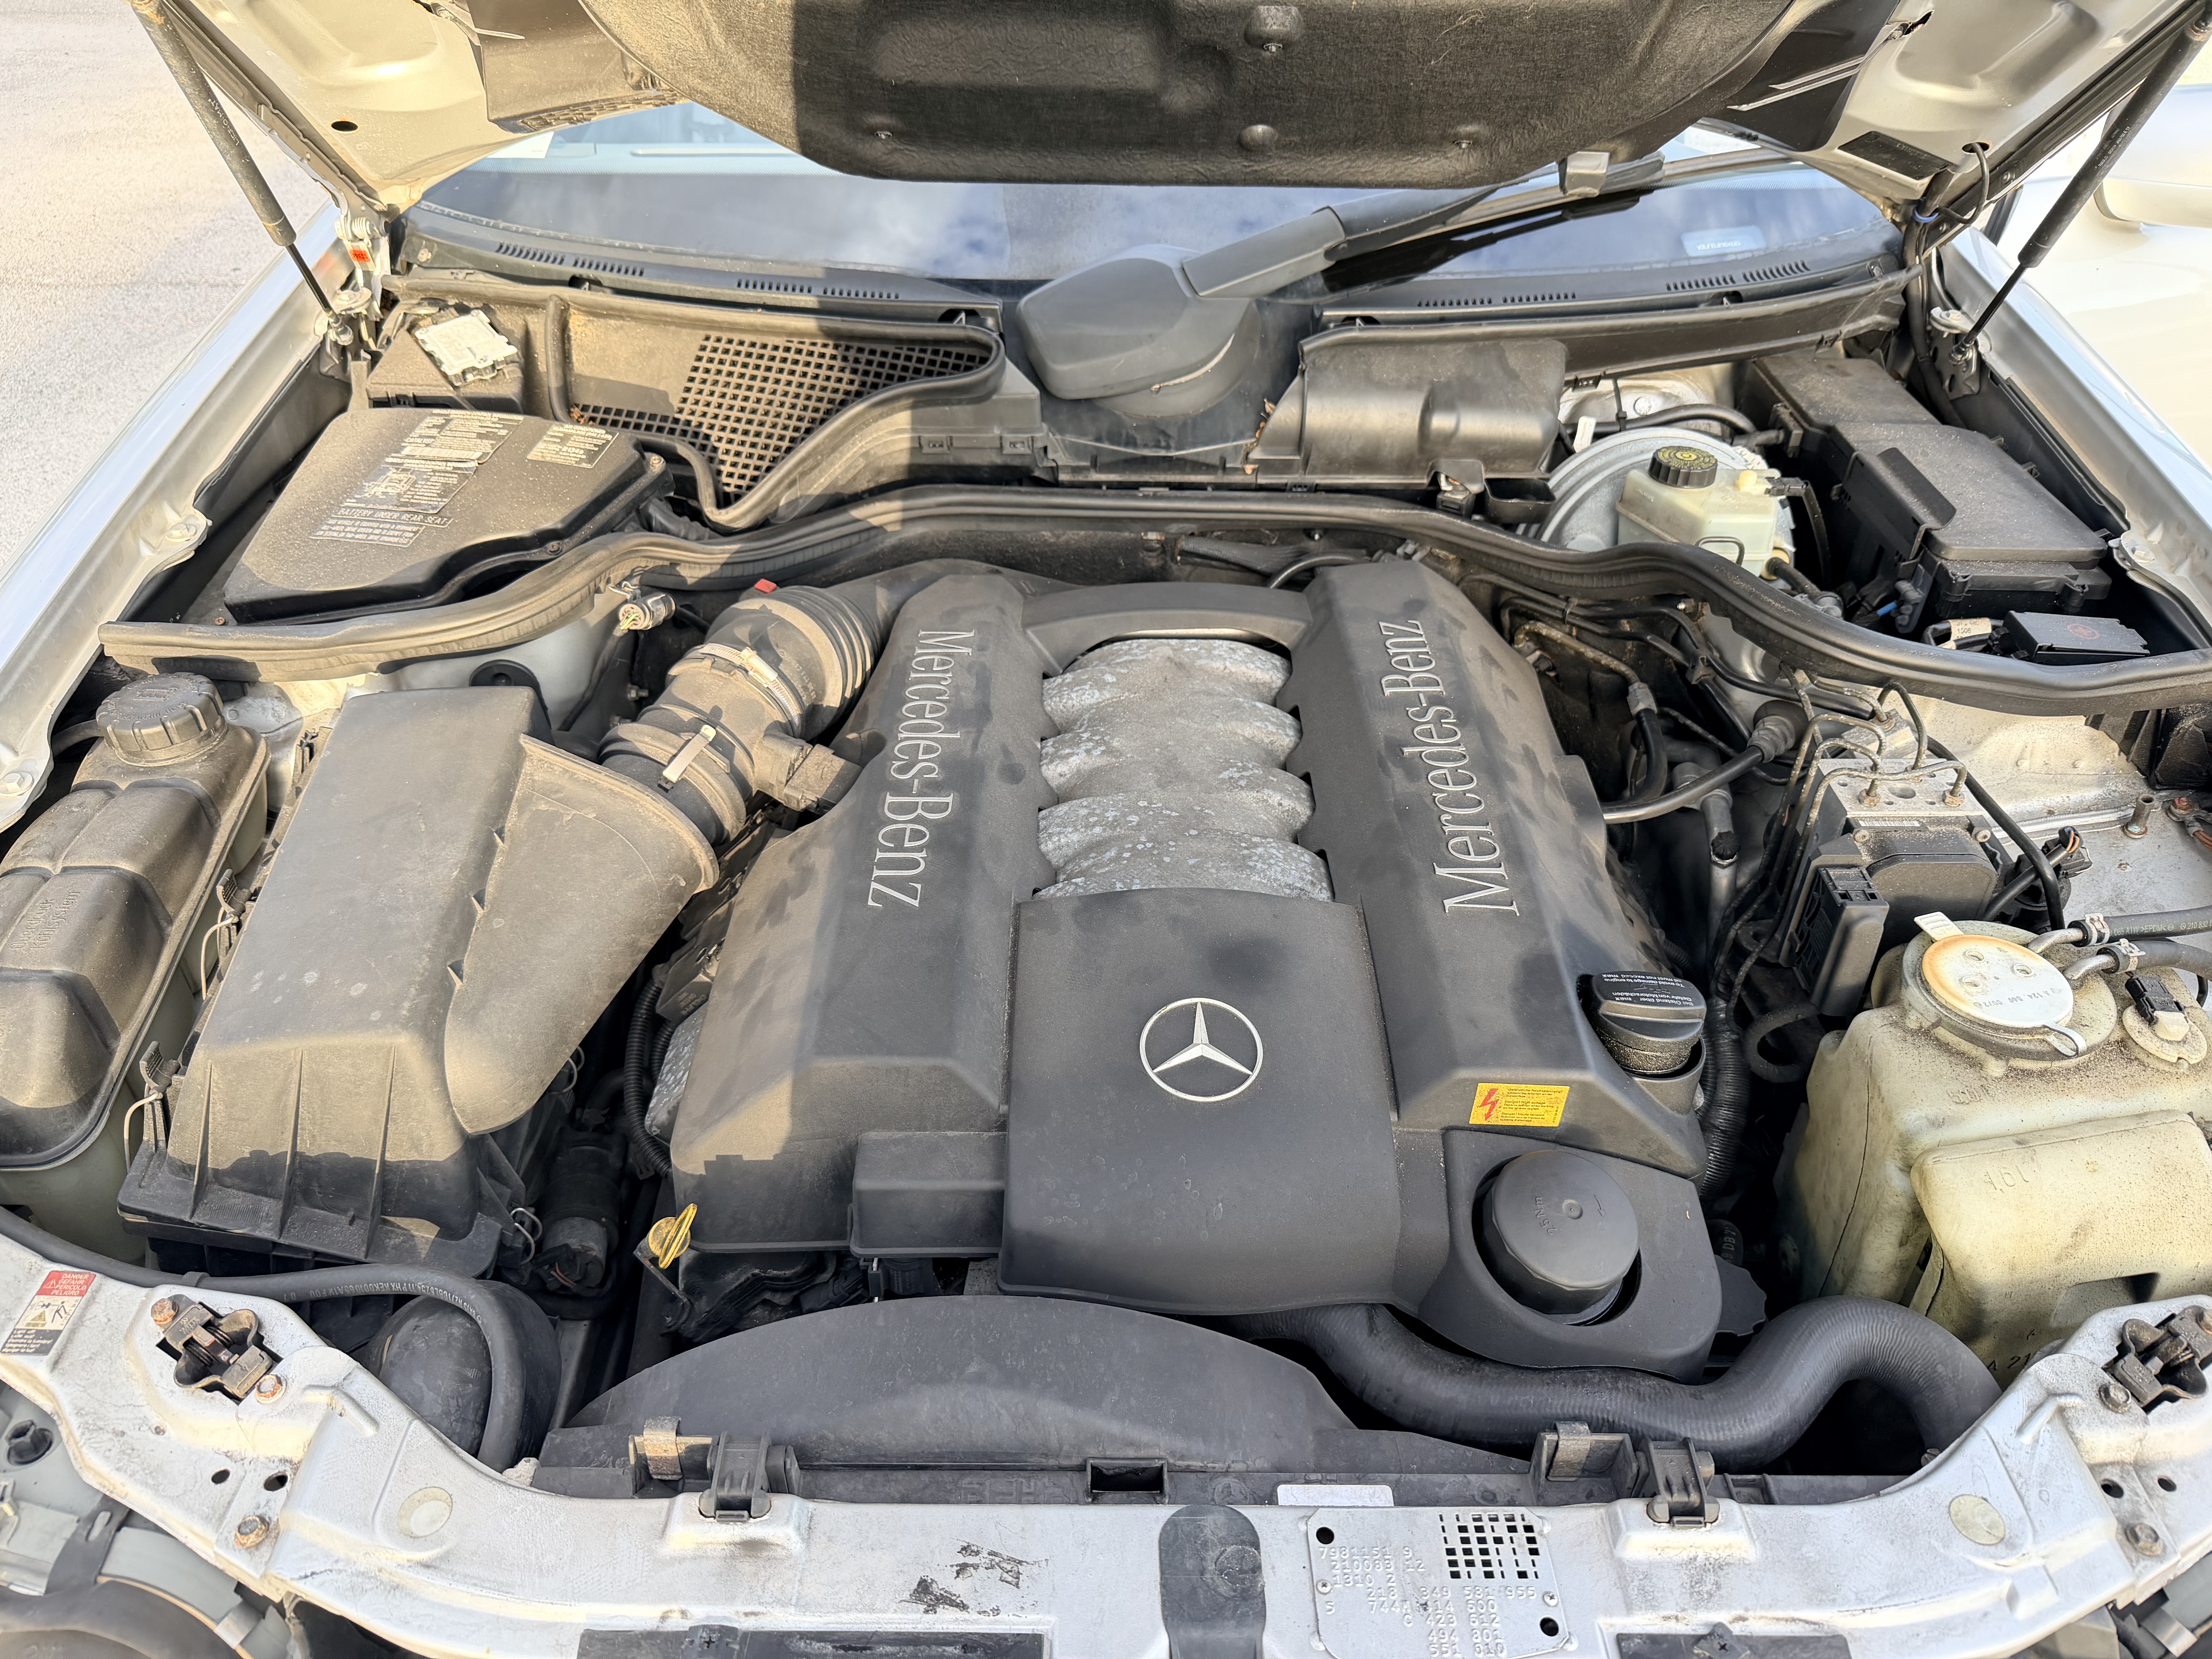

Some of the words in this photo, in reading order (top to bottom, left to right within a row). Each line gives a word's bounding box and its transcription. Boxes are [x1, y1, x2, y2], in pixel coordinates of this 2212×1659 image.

[338, 508, 373, 517] BATTERY
[374, 511, 400, 519] UNDER
[401, 513, 424, 522] REAR
[426, 516, 448, 524] SEAT
[868, 629, 975, 907] Mercedes-Benz
[1378, 620, 1520, 916] Mercedes-Benz
[1333, 1573, 1375, 1587] 1310
[1386, 1572, 1396, 1586] 2
[1505, 1586, 1537, 1599] 955
[1403, 1613, 1413, 1627] C
[1425, 1613, 1457, 1627] 423
[1428, 1628, 1460, 1643] 494
